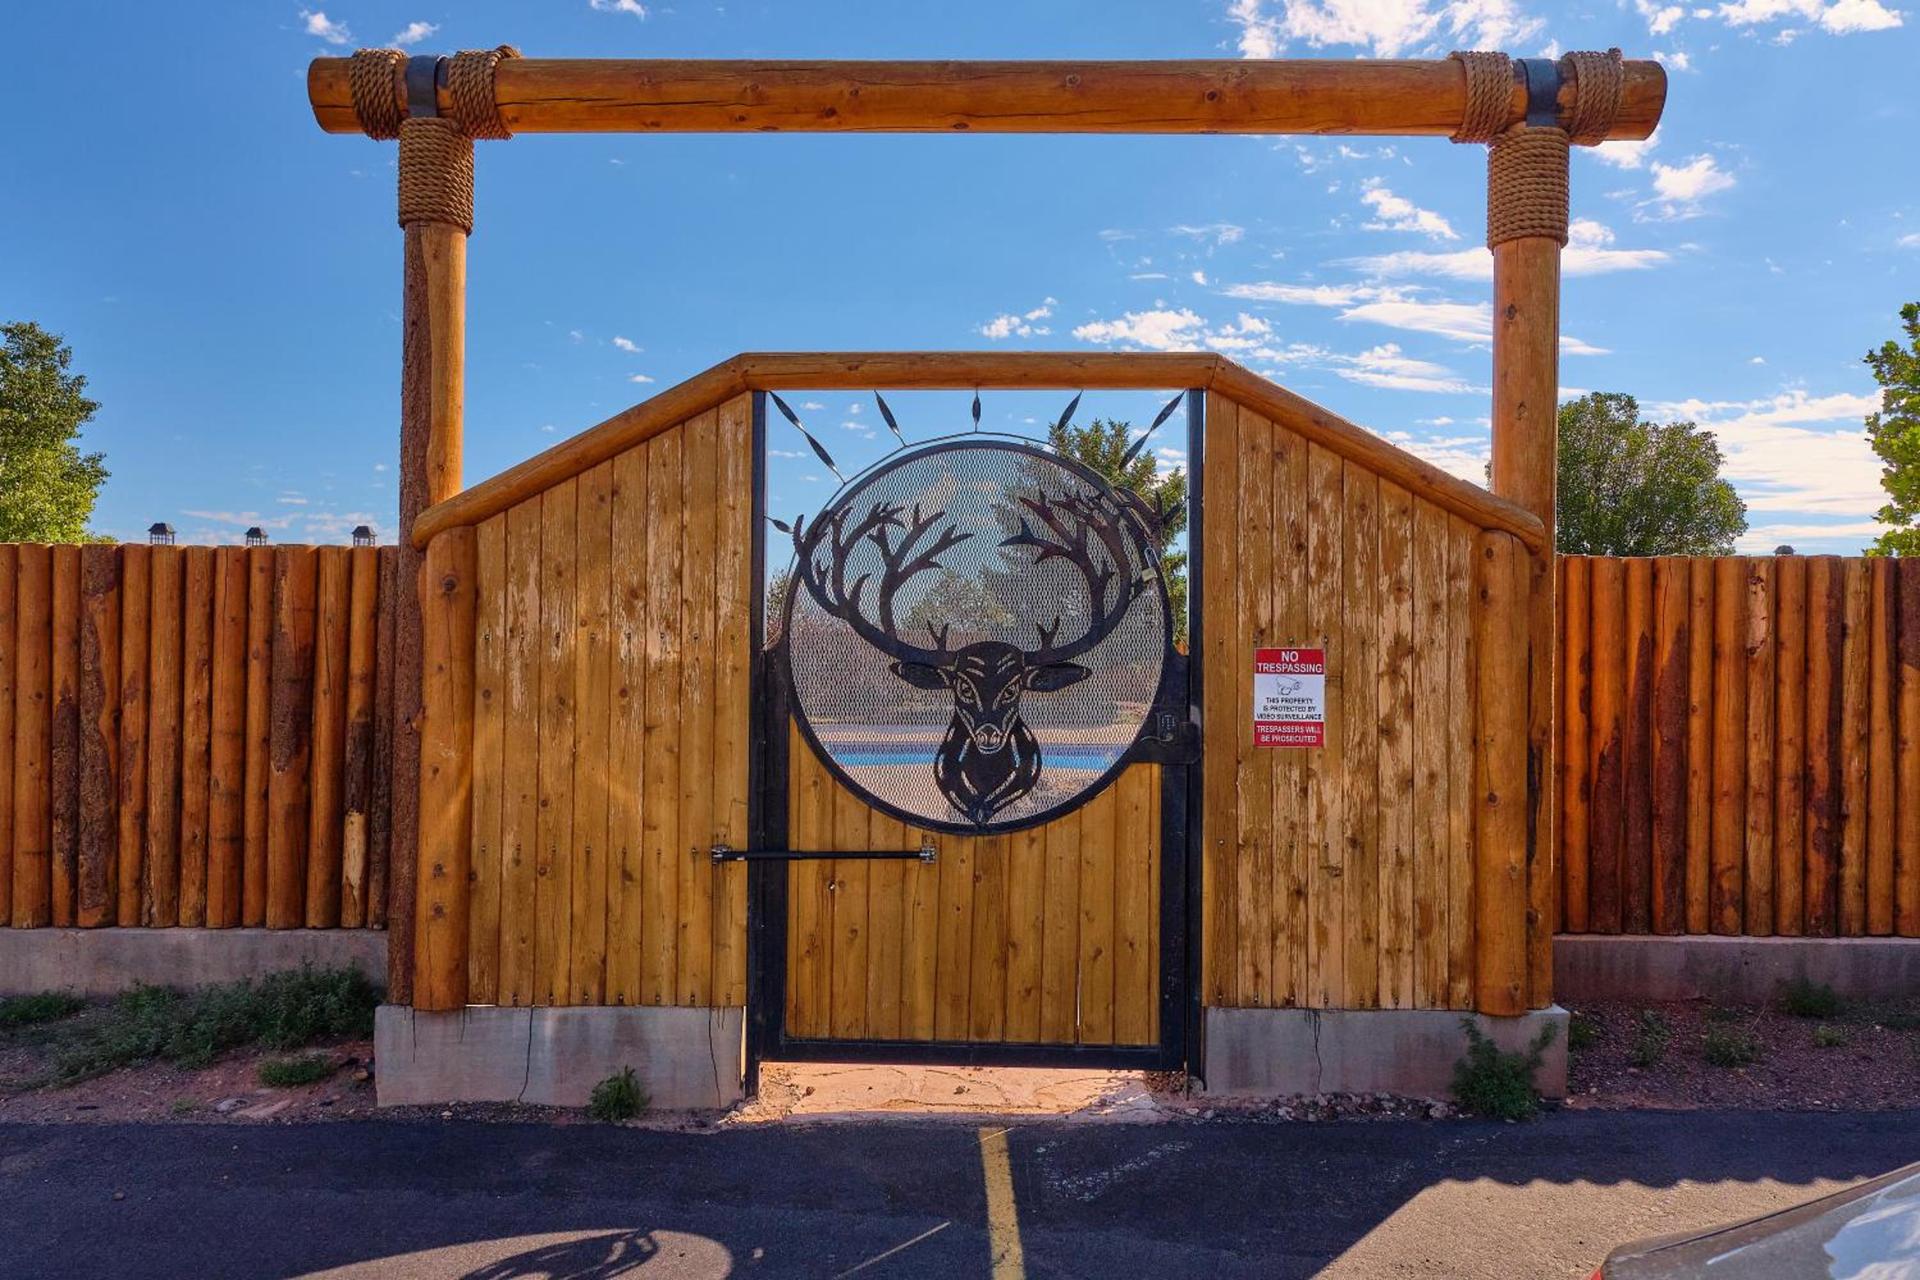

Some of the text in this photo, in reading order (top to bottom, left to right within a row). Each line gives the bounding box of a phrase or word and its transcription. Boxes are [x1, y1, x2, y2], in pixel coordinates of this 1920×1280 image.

[1281, 651, 1299, 662] NO
[1257, 663, 1322, 673] TRESPASSING
[1257, 725, 1321, 733] TRESPASSERS WILL
[1261, 735, 1317, 743] BE PROSECUTED
